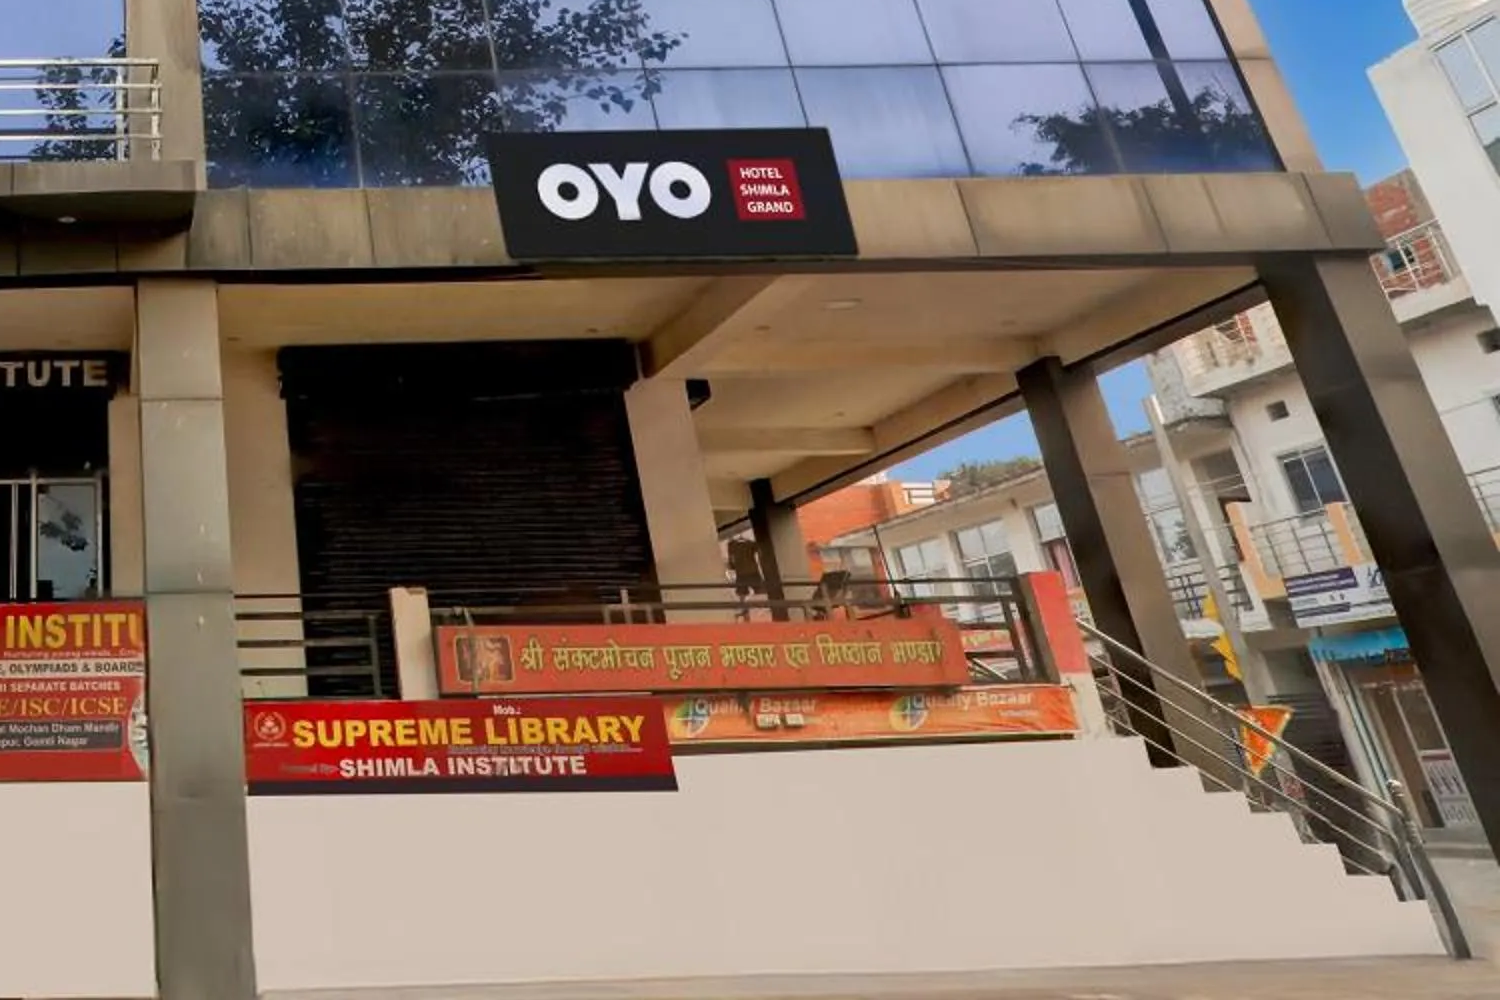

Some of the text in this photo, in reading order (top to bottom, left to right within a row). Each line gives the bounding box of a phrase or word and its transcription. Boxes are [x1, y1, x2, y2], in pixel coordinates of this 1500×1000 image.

[740, 167, 783, 180] HOTEL
[537, 161, 711, 220] OYO
[740, 183, 790, 196] SHIMLA
[747, 200, 793, 214] GRAND
[9, 662, 78, 674] OLYMPIADS
[292, 715, 645, 747] SUPREME LIBRARY
[339, 758, 439, 778] SHIMLA
[448, 756, 587, 776] INSTITUTE
